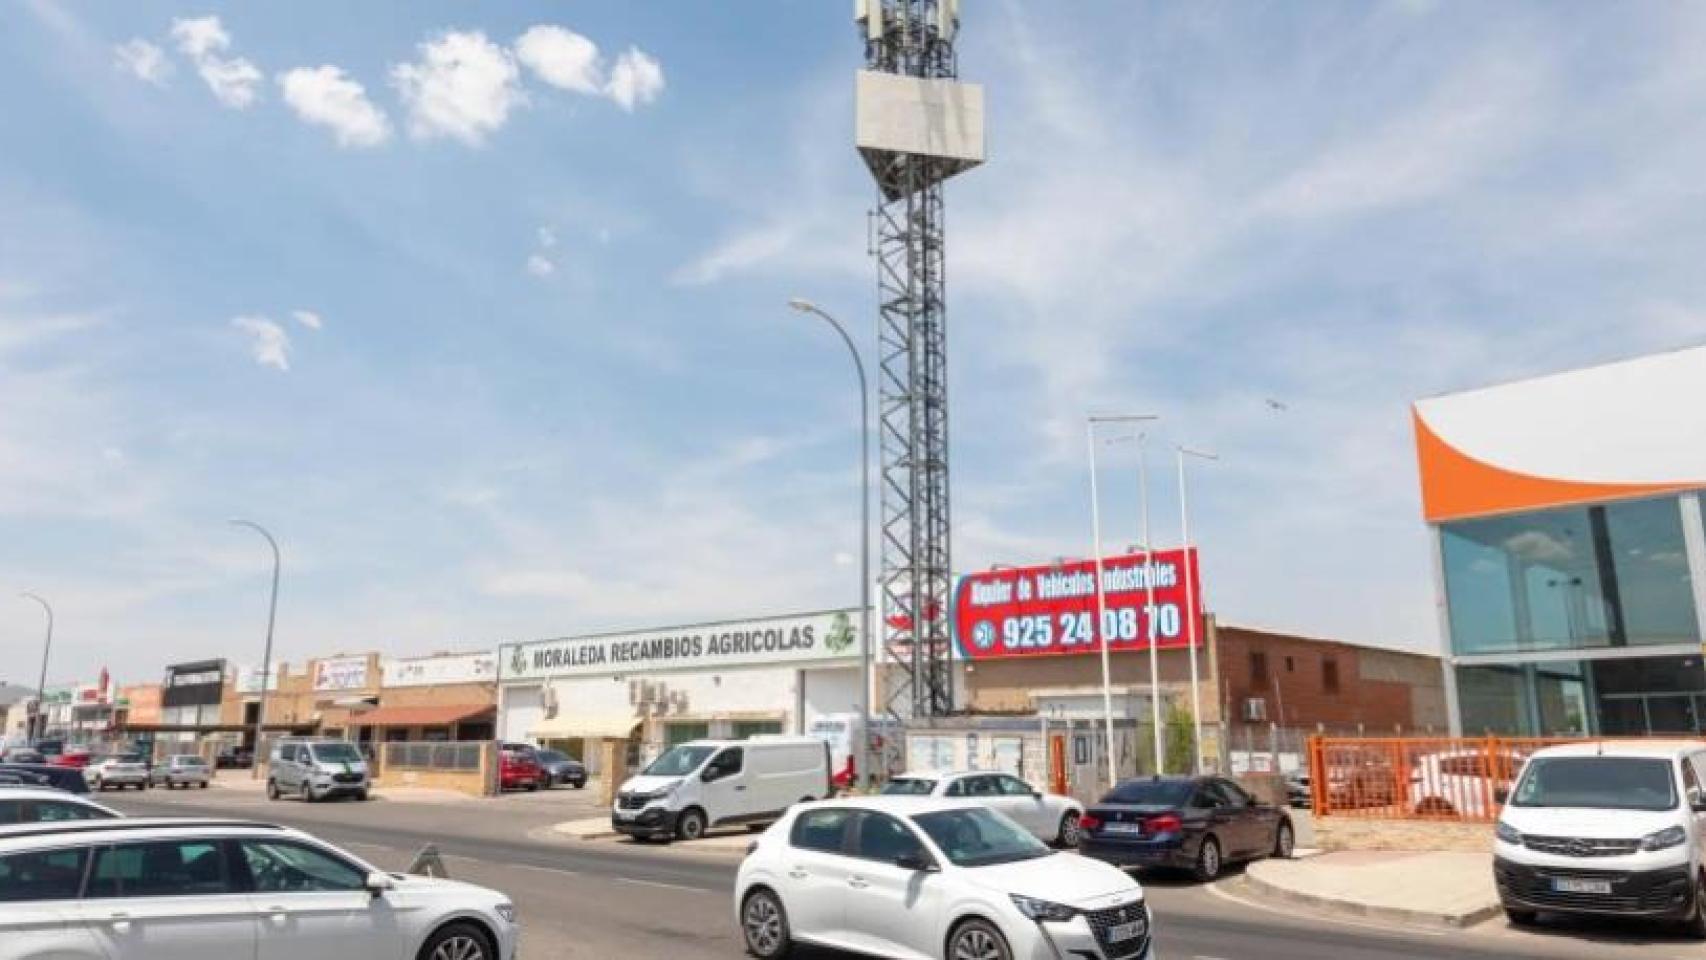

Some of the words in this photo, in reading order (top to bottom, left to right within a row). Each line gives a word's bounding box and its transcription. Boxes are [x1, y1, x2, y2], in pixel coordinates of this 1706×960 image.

[971, 579, 1012, 608] Alquiler
[1018, 574, 1031, 602] de
[1101, 560, 1177, 592] ndustriales
[533, 644, 607, 668] MORALEDA
[611, 634, 703, 663] RECAMBIOS
[708, 624, 814, 655] AGRICOLAS
[1003, 615, 1052, 647] 925
[1060, 611, 1093, 643] 24
[1101, 607, 1137, 641] 08
